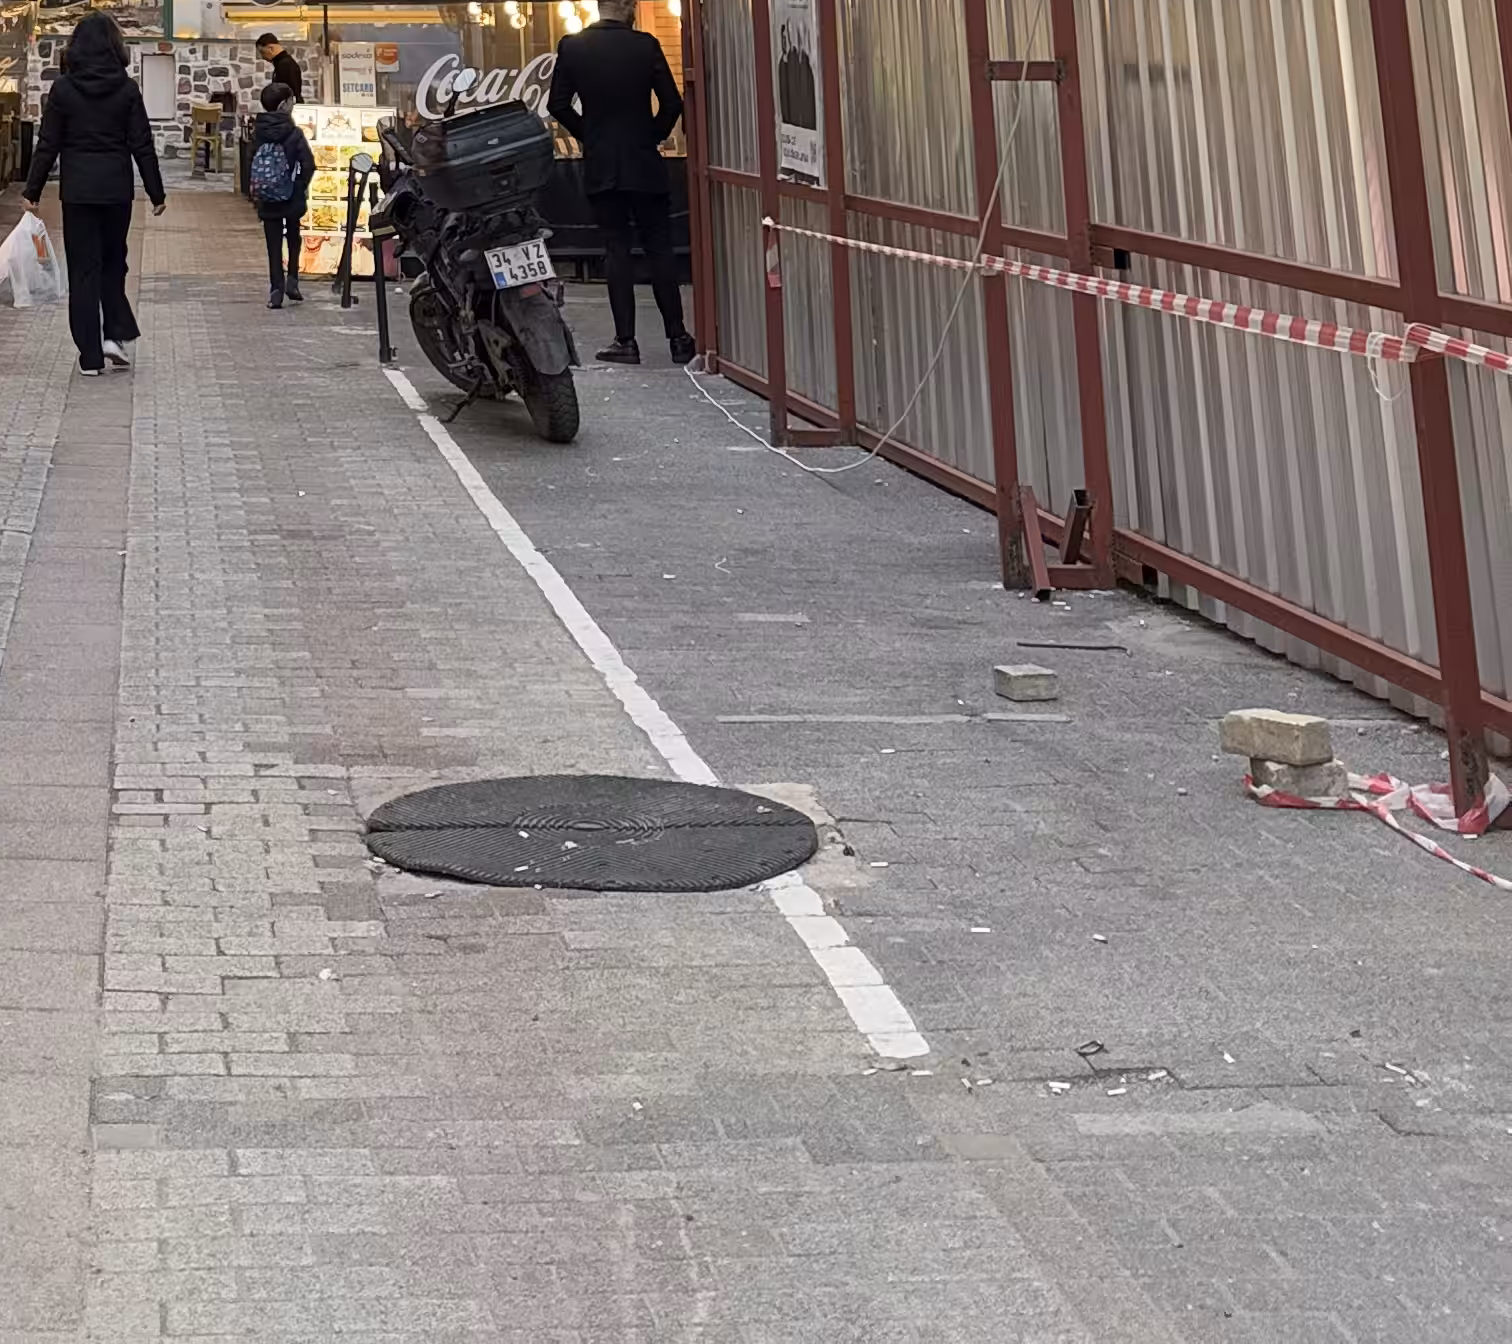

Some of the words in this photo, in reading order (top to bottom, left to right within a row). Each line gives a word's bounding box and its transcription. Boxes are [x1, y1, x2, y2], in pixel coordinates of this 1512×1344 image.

[342, 83, 374, 92] SETCARD
[492, 252, 512, 268] 34
[509, 260, 548, 281] 4358
